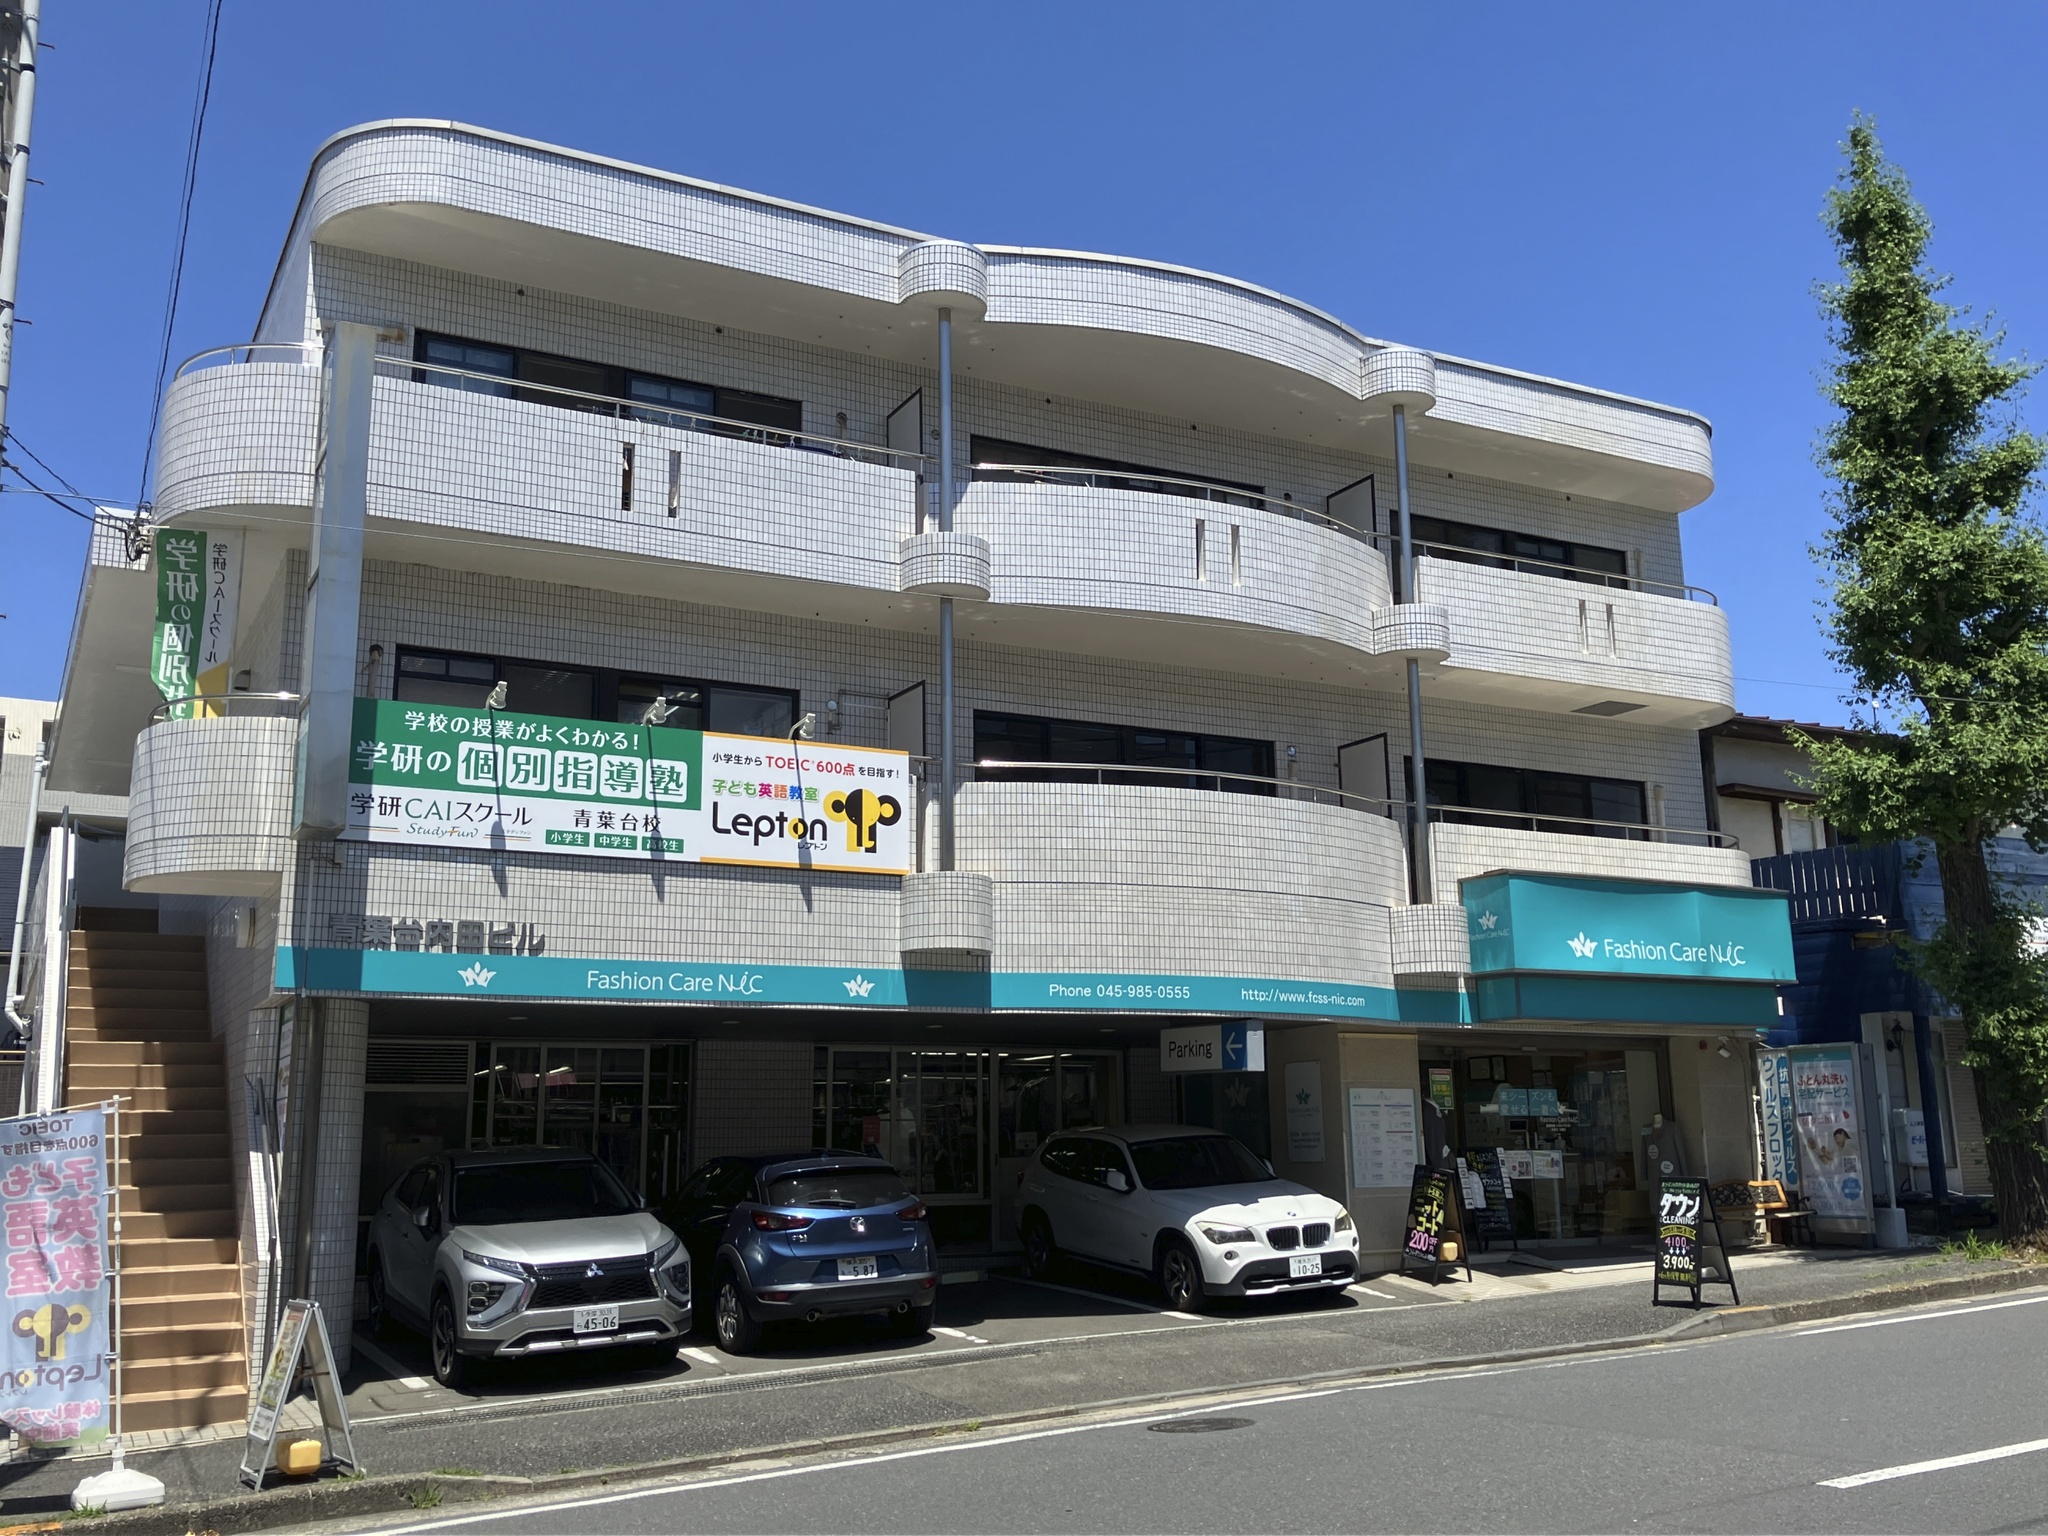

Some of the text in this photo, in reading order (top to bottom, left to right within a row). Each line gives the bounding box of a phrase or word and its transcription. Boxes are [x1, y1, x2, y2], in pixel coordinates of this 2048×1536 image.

[404, 710, 639, 750] 学校の授業がよくわかる！
[355, 740, 684, 797] 学研の個別指導塾
[712, 752, 763, 766] 小学生から
[816, 760, 855, 776] 600点
[858, 766, 900, 778] を目指す！
[712, 778, 819, 802] 子ども英語教室
[350, 793, 533, 826] 学研CAIスクール
[573, 809, 661, 833] 青葉台校
[712, 801, 828, 846] Lepton
[550, 833, 585, 845] 小学生
[599, 835, 633, 848] 中学生
[646, 839, 680, 851] 高校生
[797, 842, 828, 851] レプトン
[329, 912, 546, 955] 青葉台内田ビル
[1604, 938, 1667, 961] Fashion
[1670, 942, 1707, 962] Care
[587, 970, 664, 991] Fashion
[668, 973, 713, 992] Care
[1049, 984, 1190, 999] Phone 045-985-0555
[1241, 988, 1366, 1007] http://www.fcss-nic.com
[1168, 1041, 1213, 1060] Parking
[1797, 1086, 1850, 1100] 宅配サービス
[1660, 1192, 1700, 1218] ダウン
[1416, 1216, 1439, 1236] コート
[1662, 1215, 1695, 1226] CLEANING
[1408, 1230, 1429, 1252] 200
